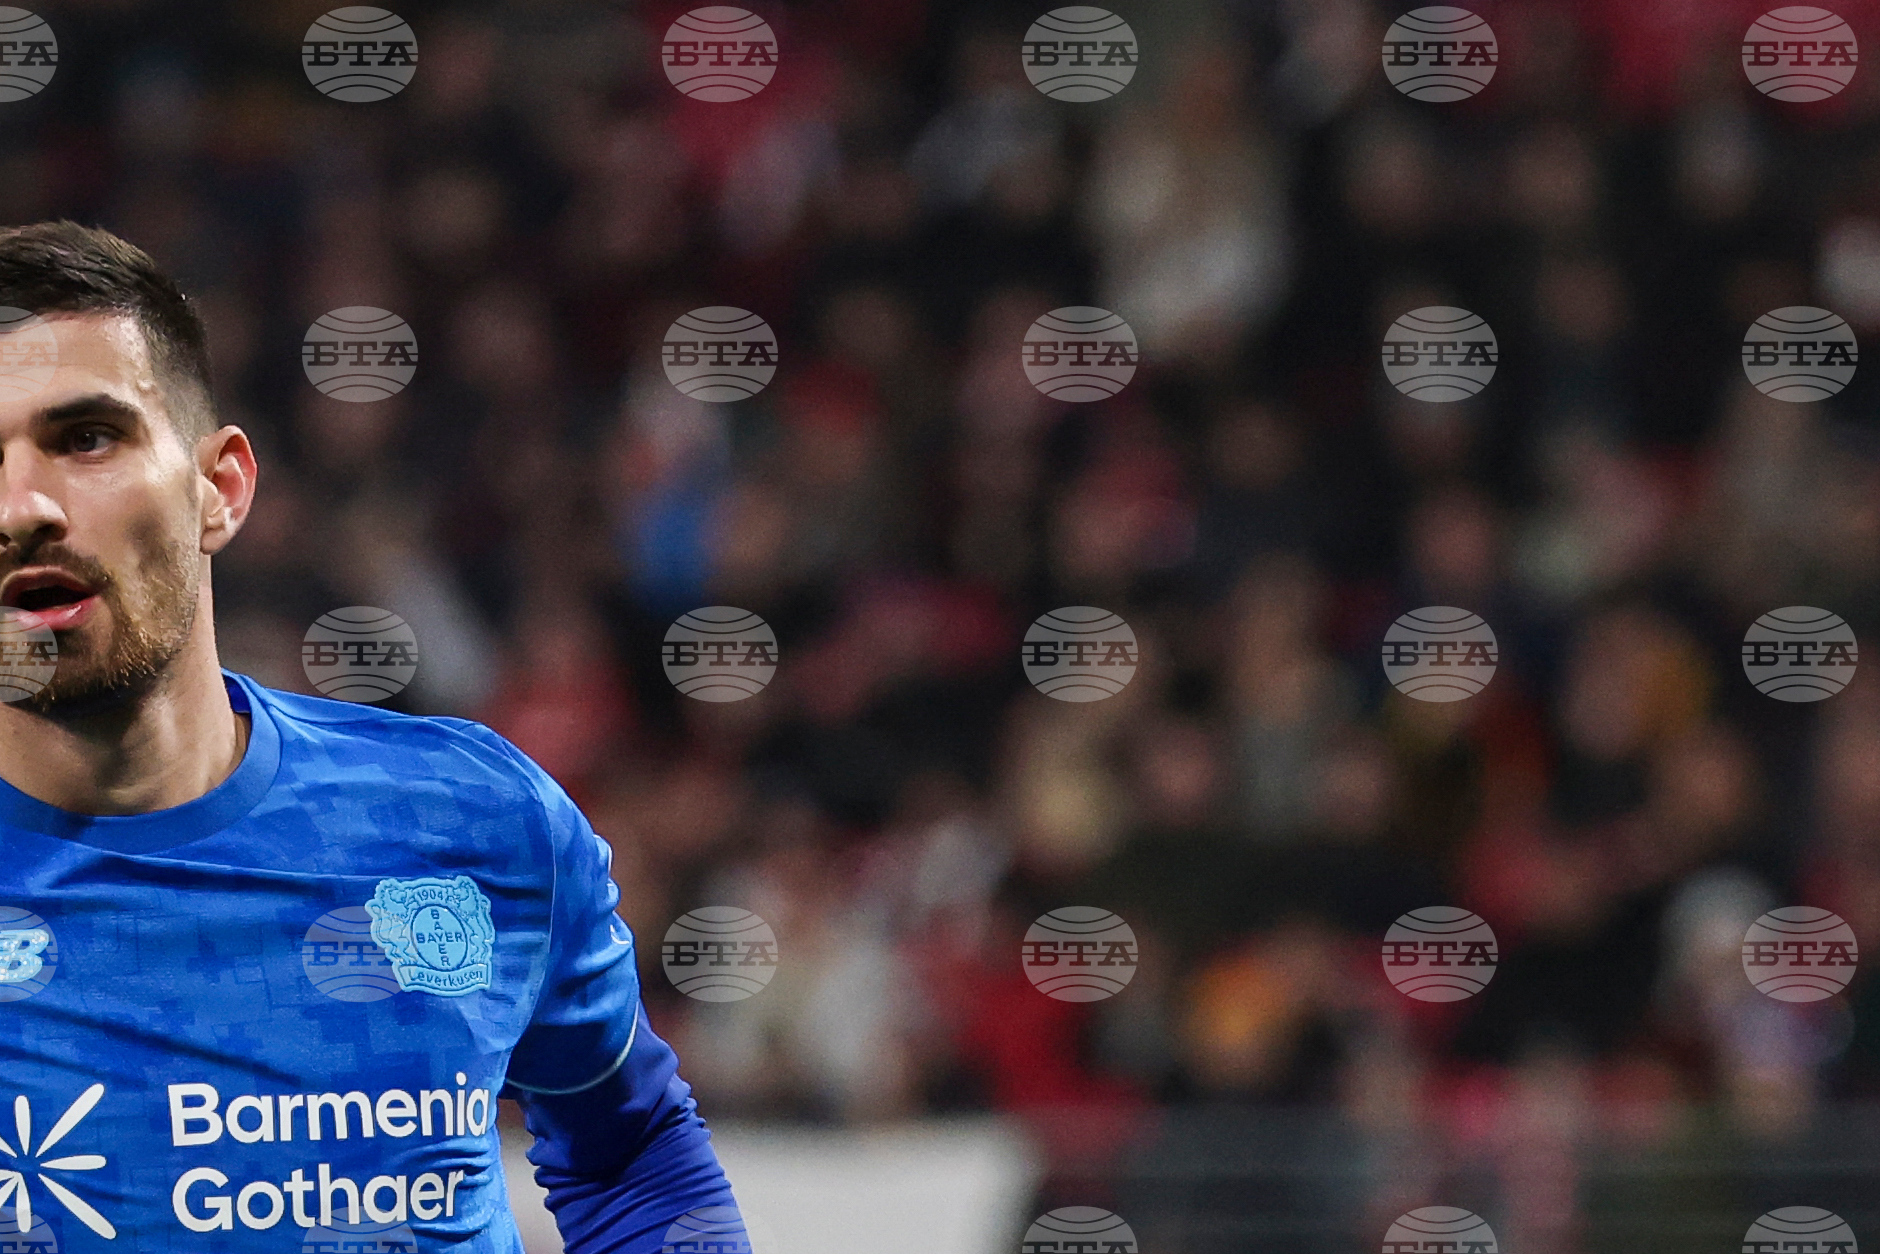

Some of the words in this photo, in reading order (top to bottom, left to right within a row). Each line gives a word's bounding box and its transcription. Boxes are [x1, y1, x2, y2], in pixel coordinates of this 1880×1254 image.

[417, 889, 443, 901] 1904
[416, 931, 465, 944] BAYER
[430, 908, 451, 967] BAYER
[407, 967, 483, 987] Leverkusen
[167, 1071, 489, 1147] Barmenia
[172, 1163, 464, 1232] Gothaer
